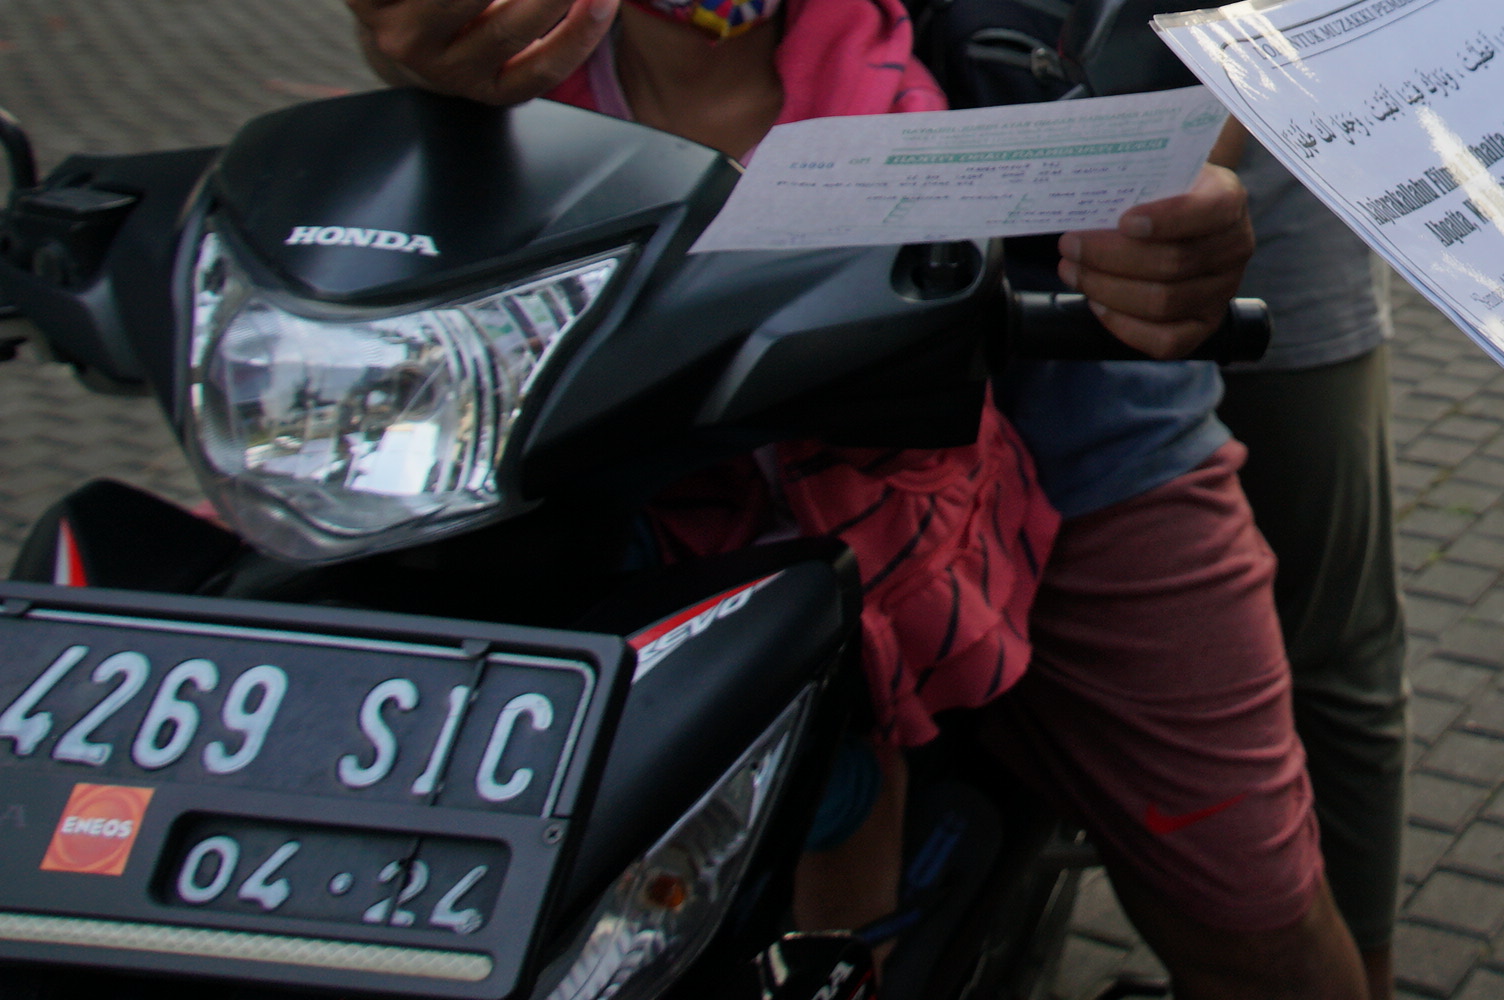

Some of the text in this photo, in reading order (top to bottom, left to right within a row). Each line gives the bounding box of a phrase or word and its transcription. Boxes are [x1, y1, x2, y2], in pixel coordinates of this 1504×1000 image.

[285, 225, 440, 257] HONDA
[0, 645, 289, 775] 4269
[60, 815, 134, 840] ENEOS
